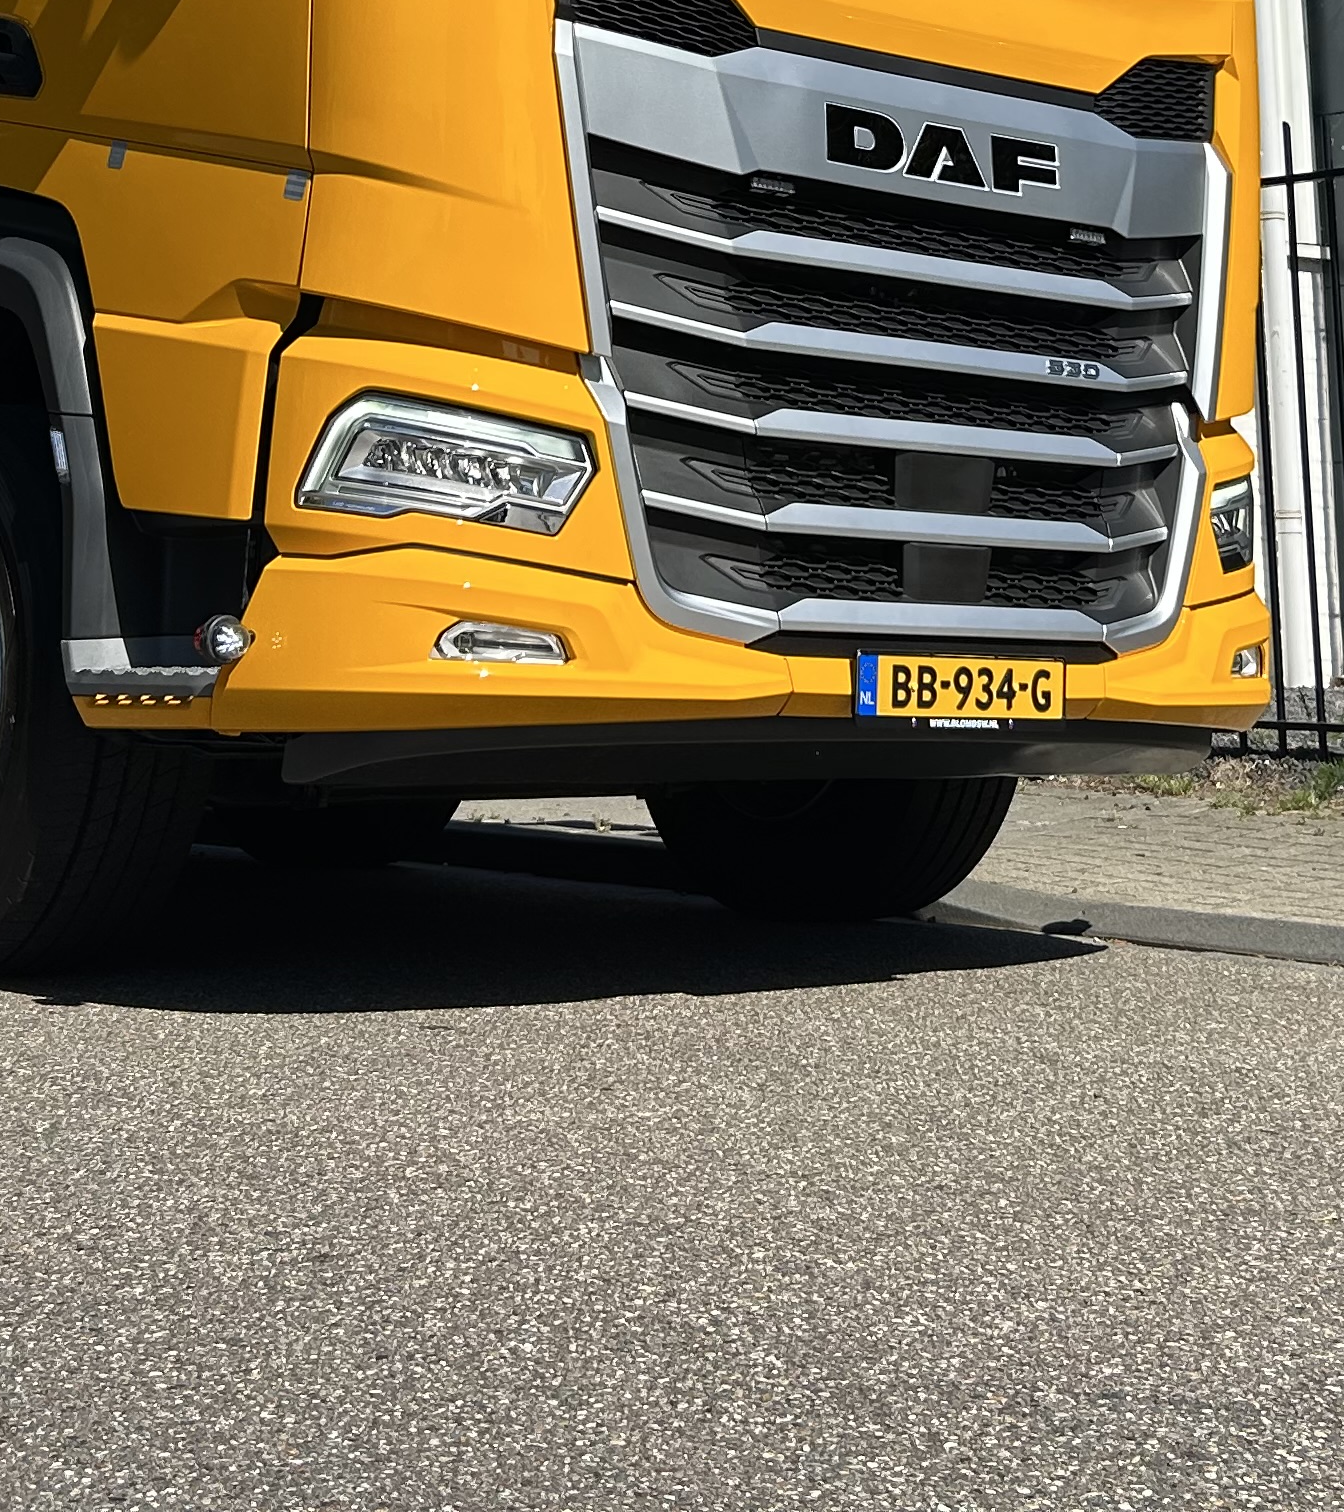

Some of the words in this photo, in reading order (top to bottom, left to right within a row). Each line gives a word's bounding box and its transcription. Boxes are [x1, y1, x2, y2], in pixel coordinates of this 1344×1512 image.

[823, 101, 1061, 197] DAF
[1046, 358, 1100, 380] 530
[859, 691, 875, 706] NL
[891, 664, 1052, 712] BB-934-G
